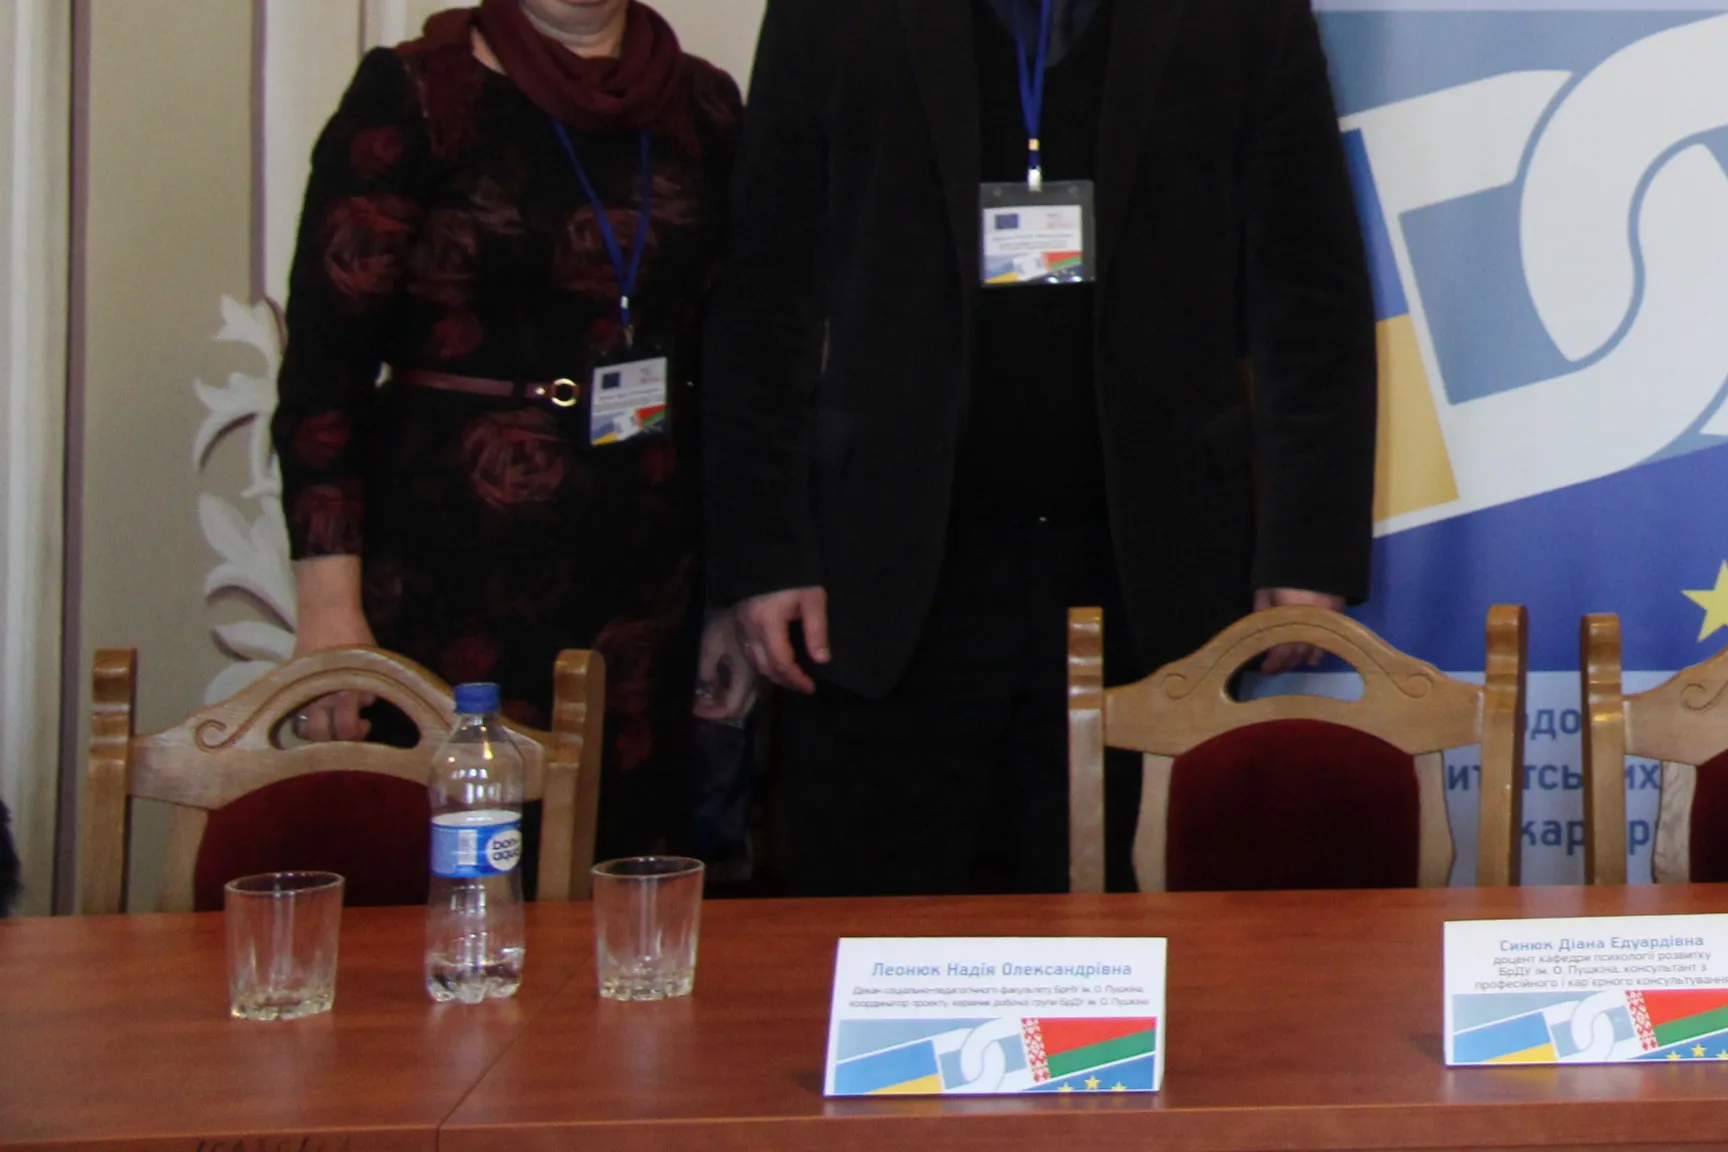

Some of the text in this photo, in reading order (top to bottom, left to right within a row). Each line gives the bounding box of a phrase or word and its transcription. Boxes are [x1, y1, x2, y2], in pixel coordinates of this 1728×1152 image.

[1499, 934, 1705, 953] Синюк Діана Едуардівна
[1493, 955, 1537, 966] доцент
[1540, 953, 1592, 964] кафедри
[1658, 950, 1712, 962] розвитку
[871, 961, 1132, 979] Леонюк Надія Олександрівна
[1624, 964, 1697, 975] консультант
[1474, 979, 1558, 990] професійного
